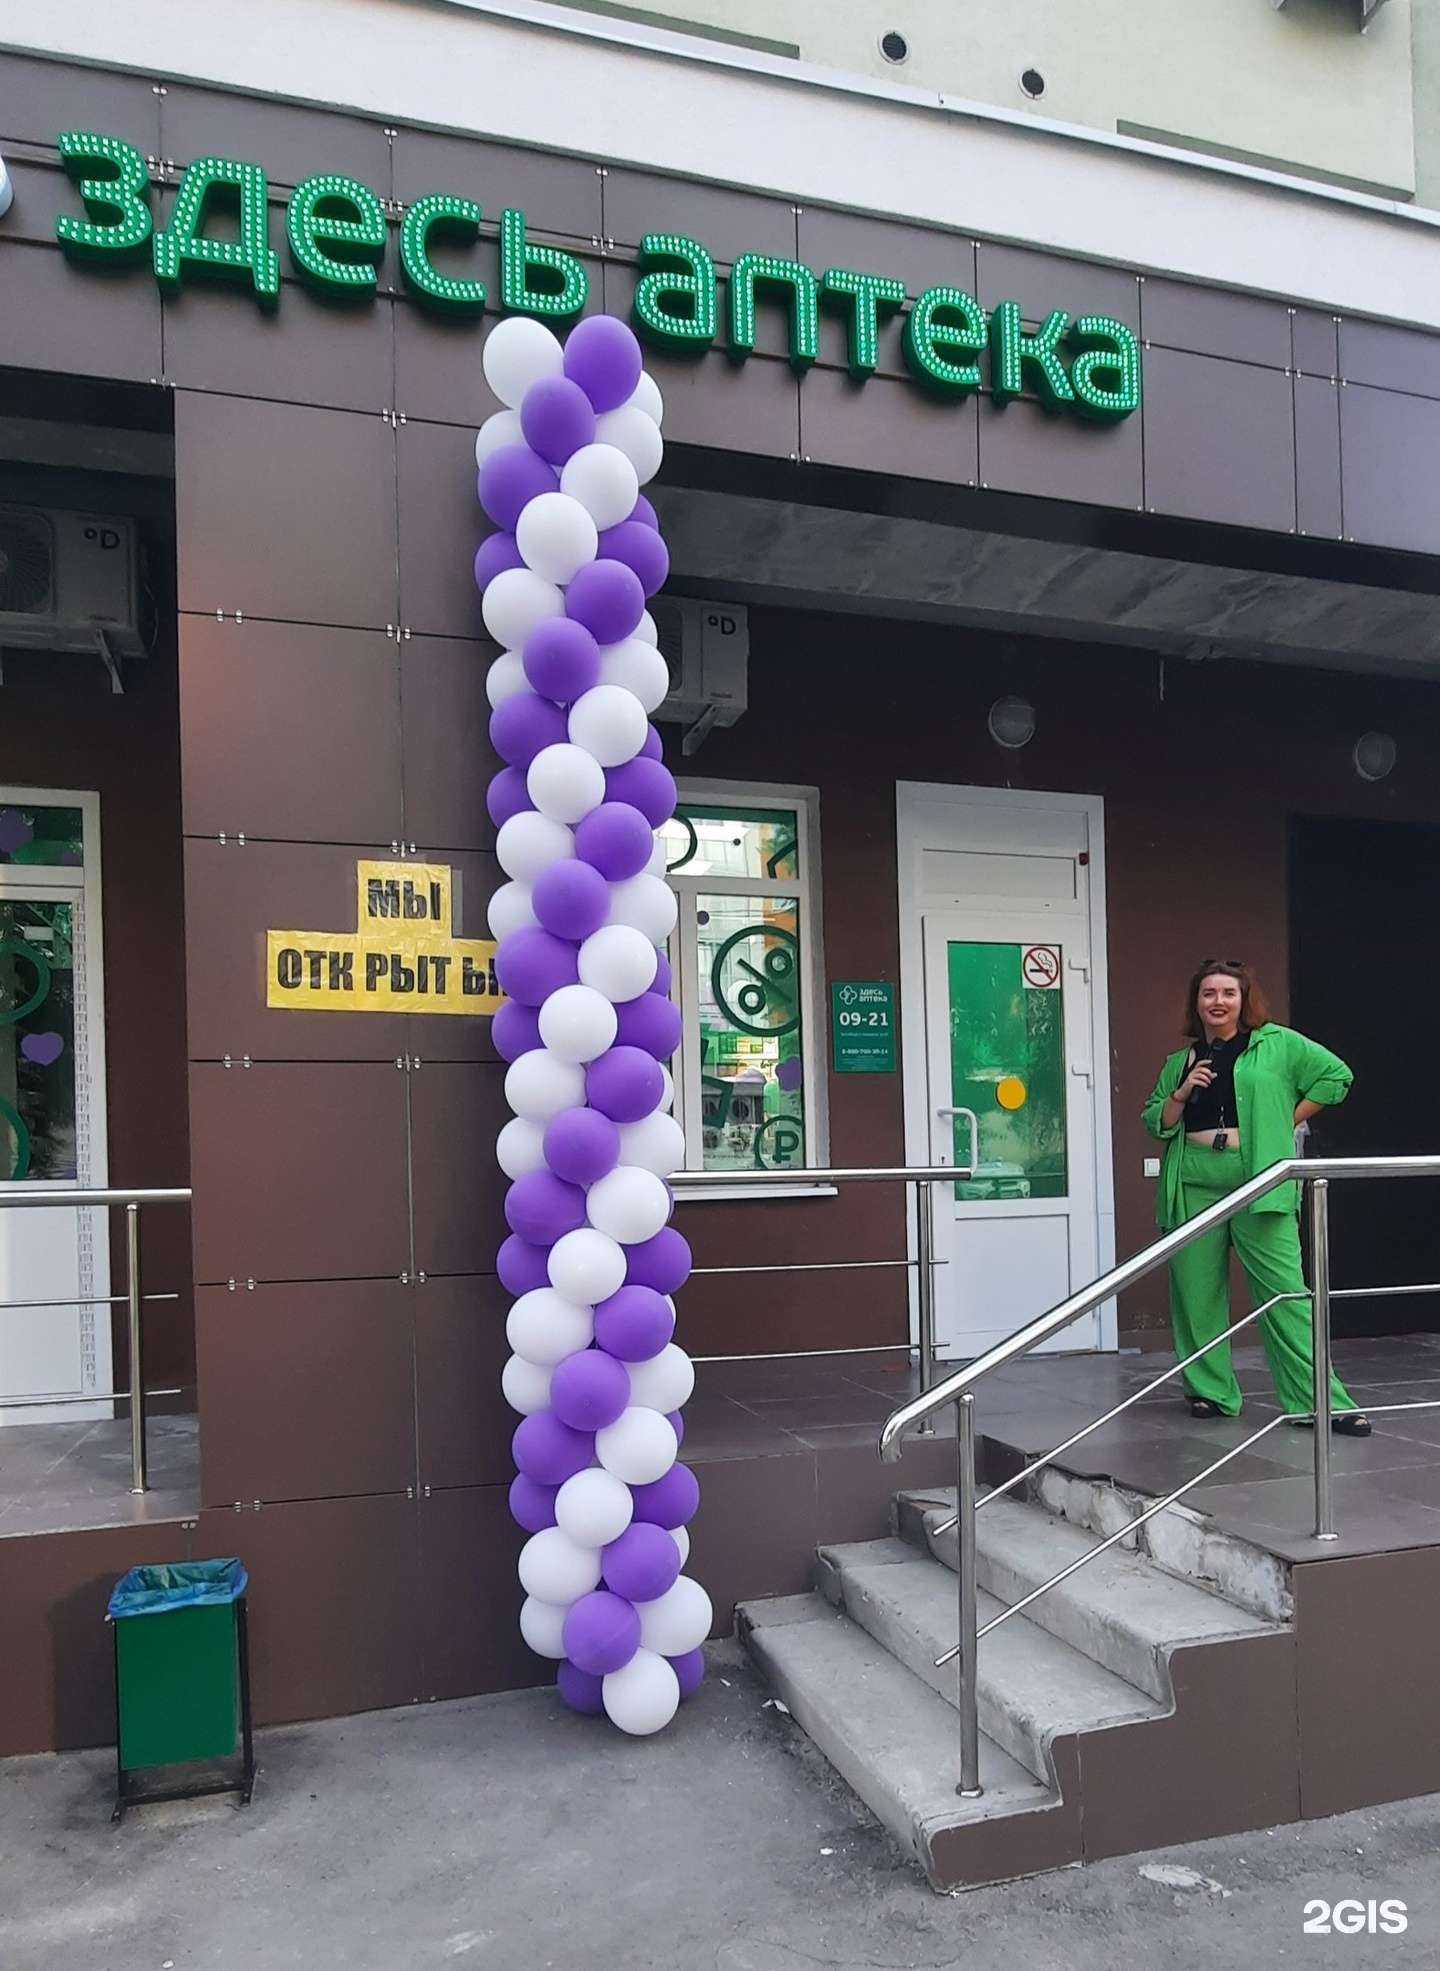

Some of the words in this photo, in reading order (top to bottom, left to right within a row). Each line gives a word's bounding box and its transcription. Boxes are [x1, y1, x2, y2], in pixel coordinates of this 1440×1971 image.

[633, 233, 1140, 421] аптека
[367, 878, 441, 920] МЫ
[277, 948, 508, 997] ОТКРЫТЫ
[839, 1012, 889, 1026] 09-21
